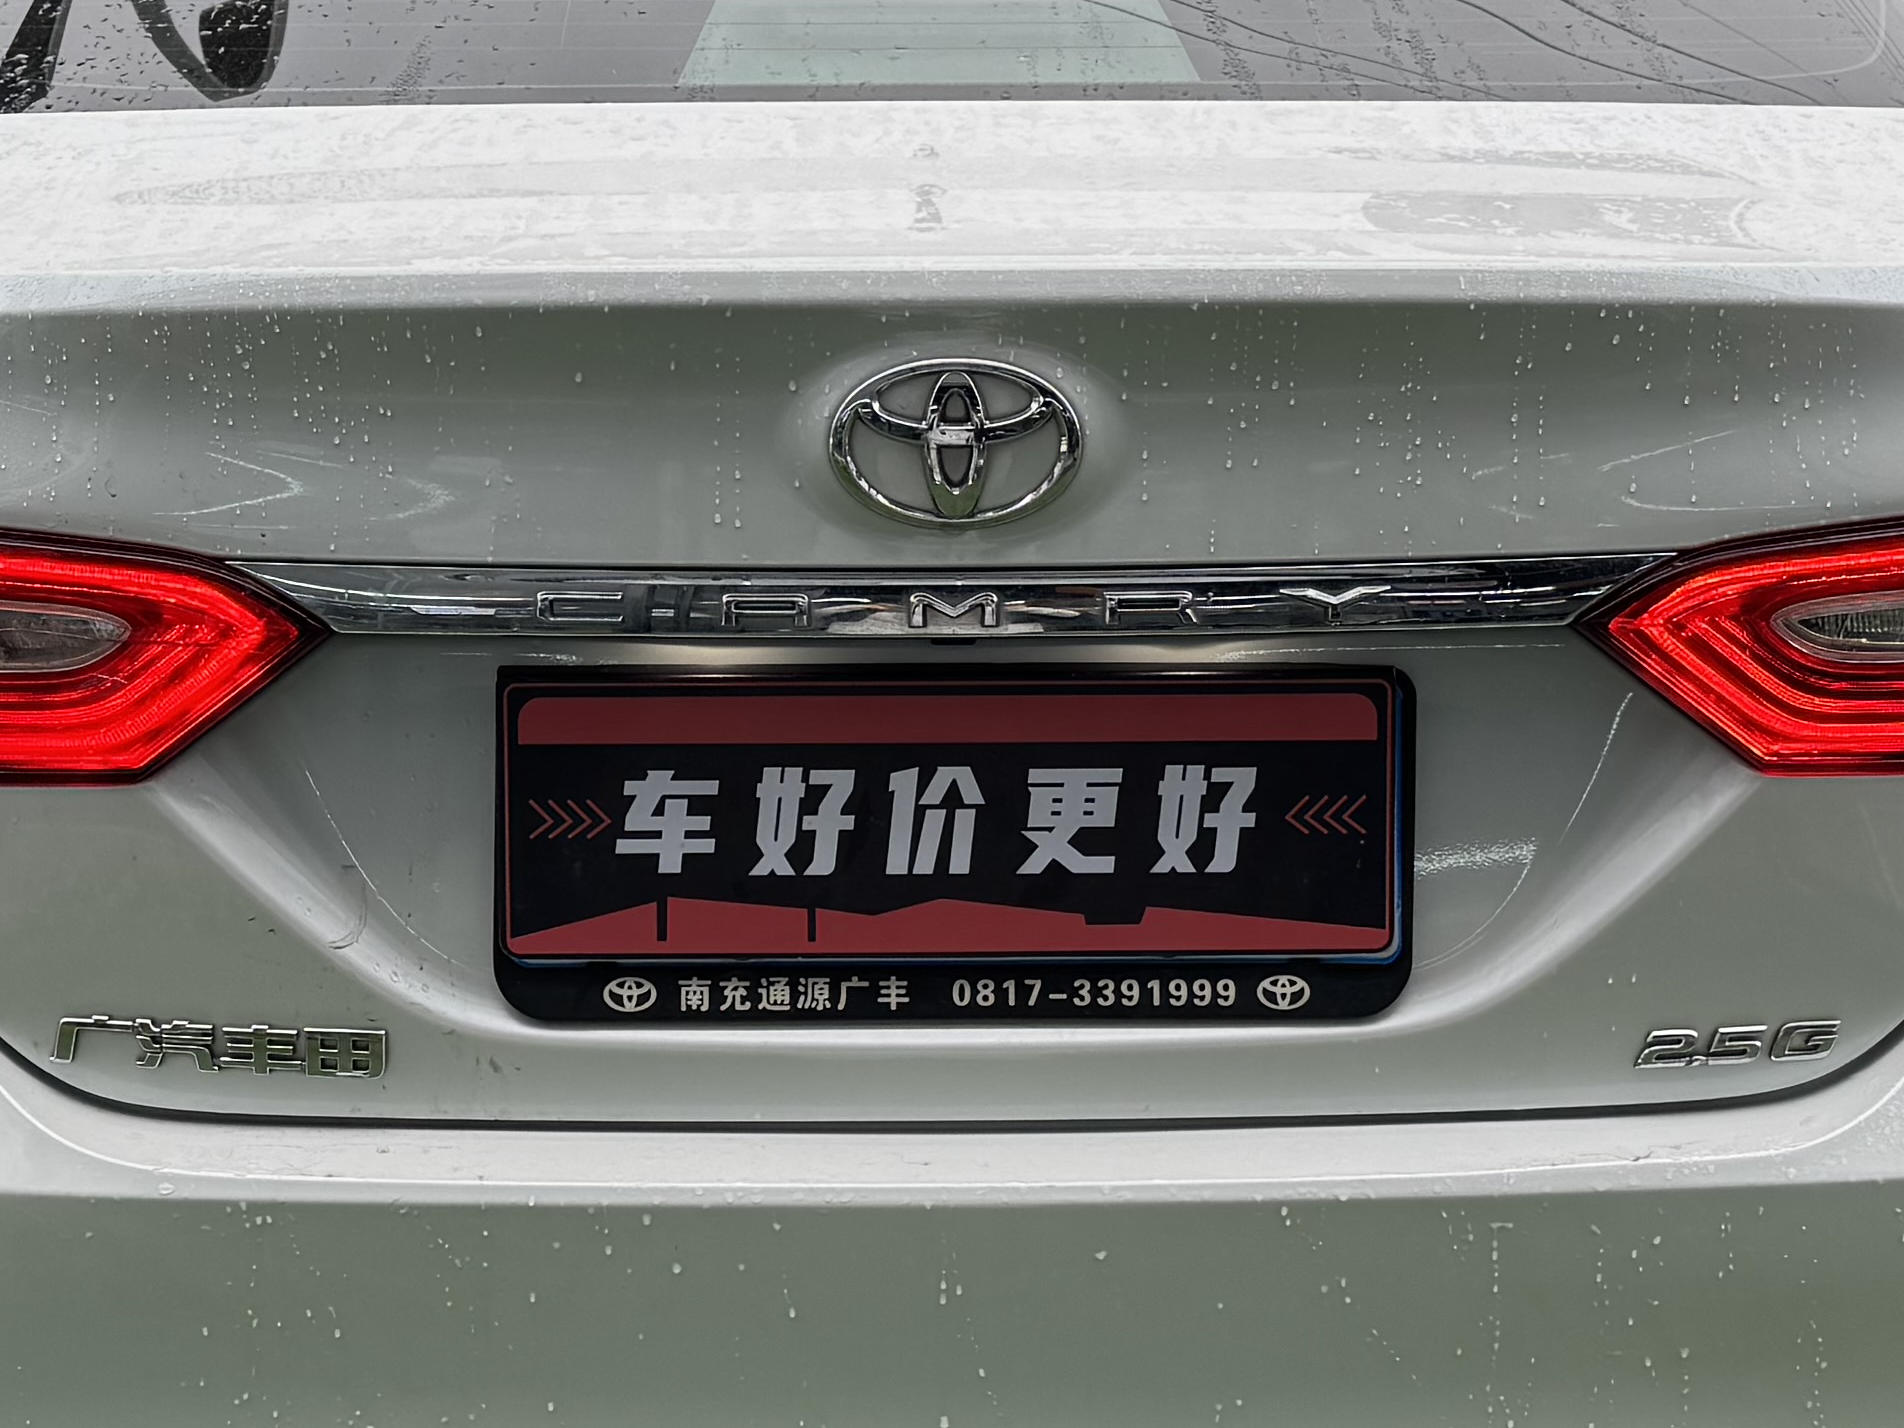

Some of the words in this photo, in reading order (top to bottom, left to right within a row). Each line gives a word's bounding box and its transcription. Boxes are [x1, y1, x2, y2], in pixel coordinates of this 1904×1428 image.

[536, 585, 1392, 629] CAMRY
[614, 765, 1258, 877] 车好价更好
[678, 976, 912, 1013] 南充通源广丰
[952, 979, 1239, 1008] 0817-3391999
[49, 1015, 387, 1079] 广汽丰田
